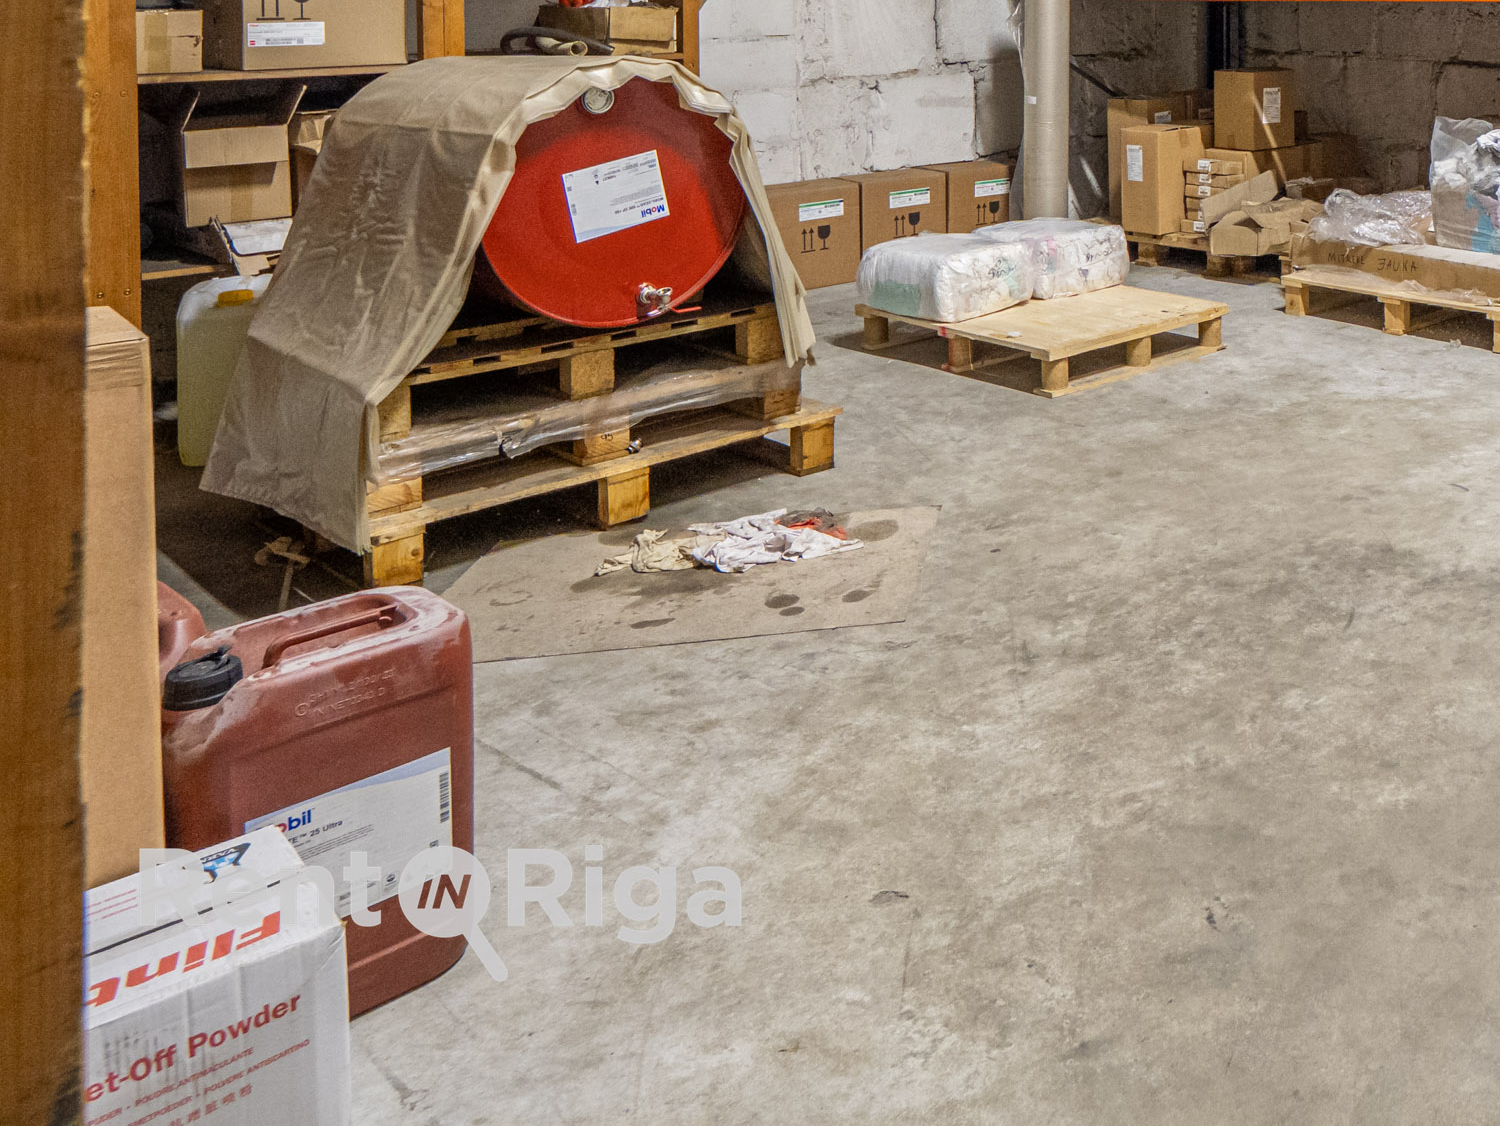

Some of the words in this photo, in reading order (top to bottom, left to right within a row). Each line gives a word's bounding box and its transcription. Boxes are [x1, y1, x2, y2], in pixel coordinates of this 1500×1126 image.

[641, 204, 665, 217] Mobil
[276, 809, 312, 833] obil
[310, 827, 320, 837] 25
[323, 820, 343, 832] Ultra
[85, 911, 281, 1007] Flint
[84, 1043, 177, 1103] et-Off
[188, 994, 301, 1059] Powder
